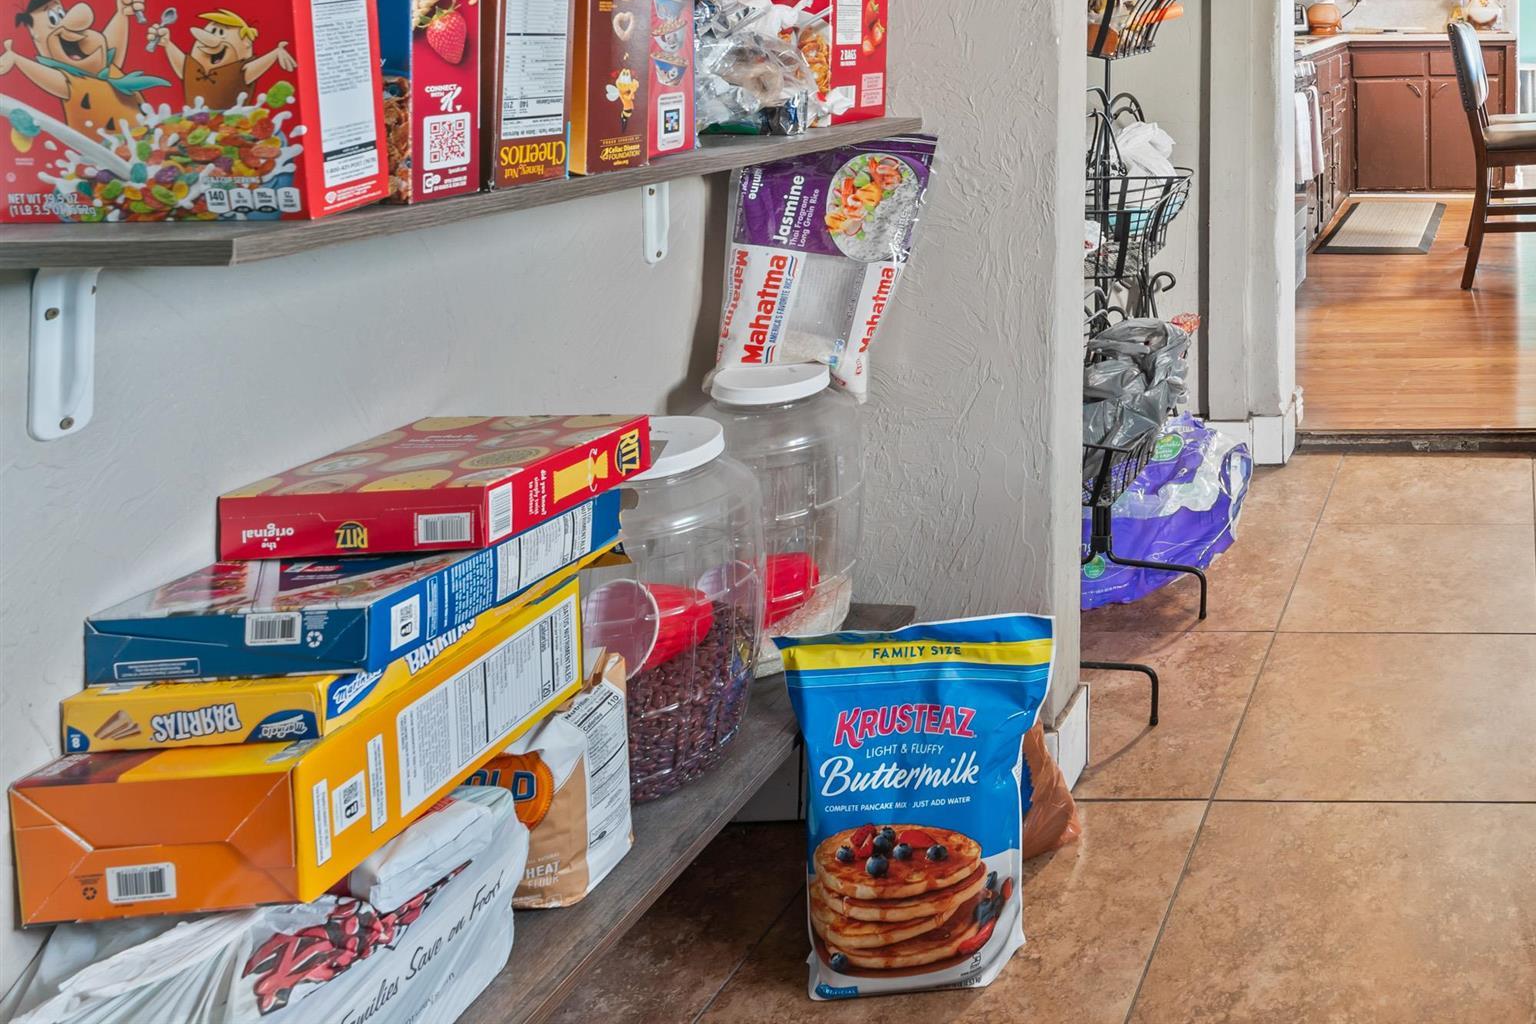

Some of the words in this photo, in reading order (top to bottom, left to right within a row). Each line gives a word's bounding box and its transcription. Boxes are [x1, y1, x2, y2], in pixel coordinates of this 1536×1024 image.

[845, 49, 857, 60] BAGS
[424, 84, 457, 93] CONNECT
[500, 140, 566, 166] Cheerios
[8, 193, 25, 204] NET
[26, 193, 42, 204] WT
[208, 190, 225, 201] 140
[21, 205, 33, 216] LB
[34, 205, 49, 216] 3.5
[772, 174, 805, 246] Jasmine
[789, 226, 798, 246] Thai
[796, 195, 810, 228] Fragrant
[798, 226, 807, 248] Long
[803, 206, 815, 228] Grain
[810, 188, 820, 205] Rice
[741, 254, 788, 364] Mahatma
[769, 311, 782, 343] AMERICA'S
[776, 286, 789, 313] FAVORITE
[785, 275, 794, 288] RICE
[858, 266, 896, 354] Mahatma
[620, 428, 640, 477] RITZ
[241, 523, 294, 543] original
[260, 539, 278, 551] the
[335, 524, 368, 549] RITZ
[563, 603, 571, 628] DATOS
[563, 628, 573, 682] NUTRIMENTALES
[872, 646, 924, 659] FAMILY
[931, 645, 962, 656] SIZE
[542, 680, 552, 699] 120
[150, 702, 243, 743] BARRiTAS
[583, 713, 603, 732] Calories
[607, 695, 619, 706] 110
[833, 702, 976, 749] KRUSTEAZ
[261, 714, 308, 739] Marinela
[72, 736, 80, 749] 8
[866, 744, 897, 759] LIGHT
[900, 744, 908, 754] &
[911, 743, 944, 755] FLUFFY
[464, 768, 537, 802] OLD
[819, 751, 980, 797] Buttermilk
[824, 803, 859, 813] COMPLETE
[860, 801, 895, 812] PANCAKE
[895, 801, 908, 809] MIX
[912, 800, 930, 809] JUST
[931, 798, 947, 807] ADD
[948, 795, 971, 805] WATER
[525, 861, 560, 880] HEAT
[405, 937, 443, 982] Save
